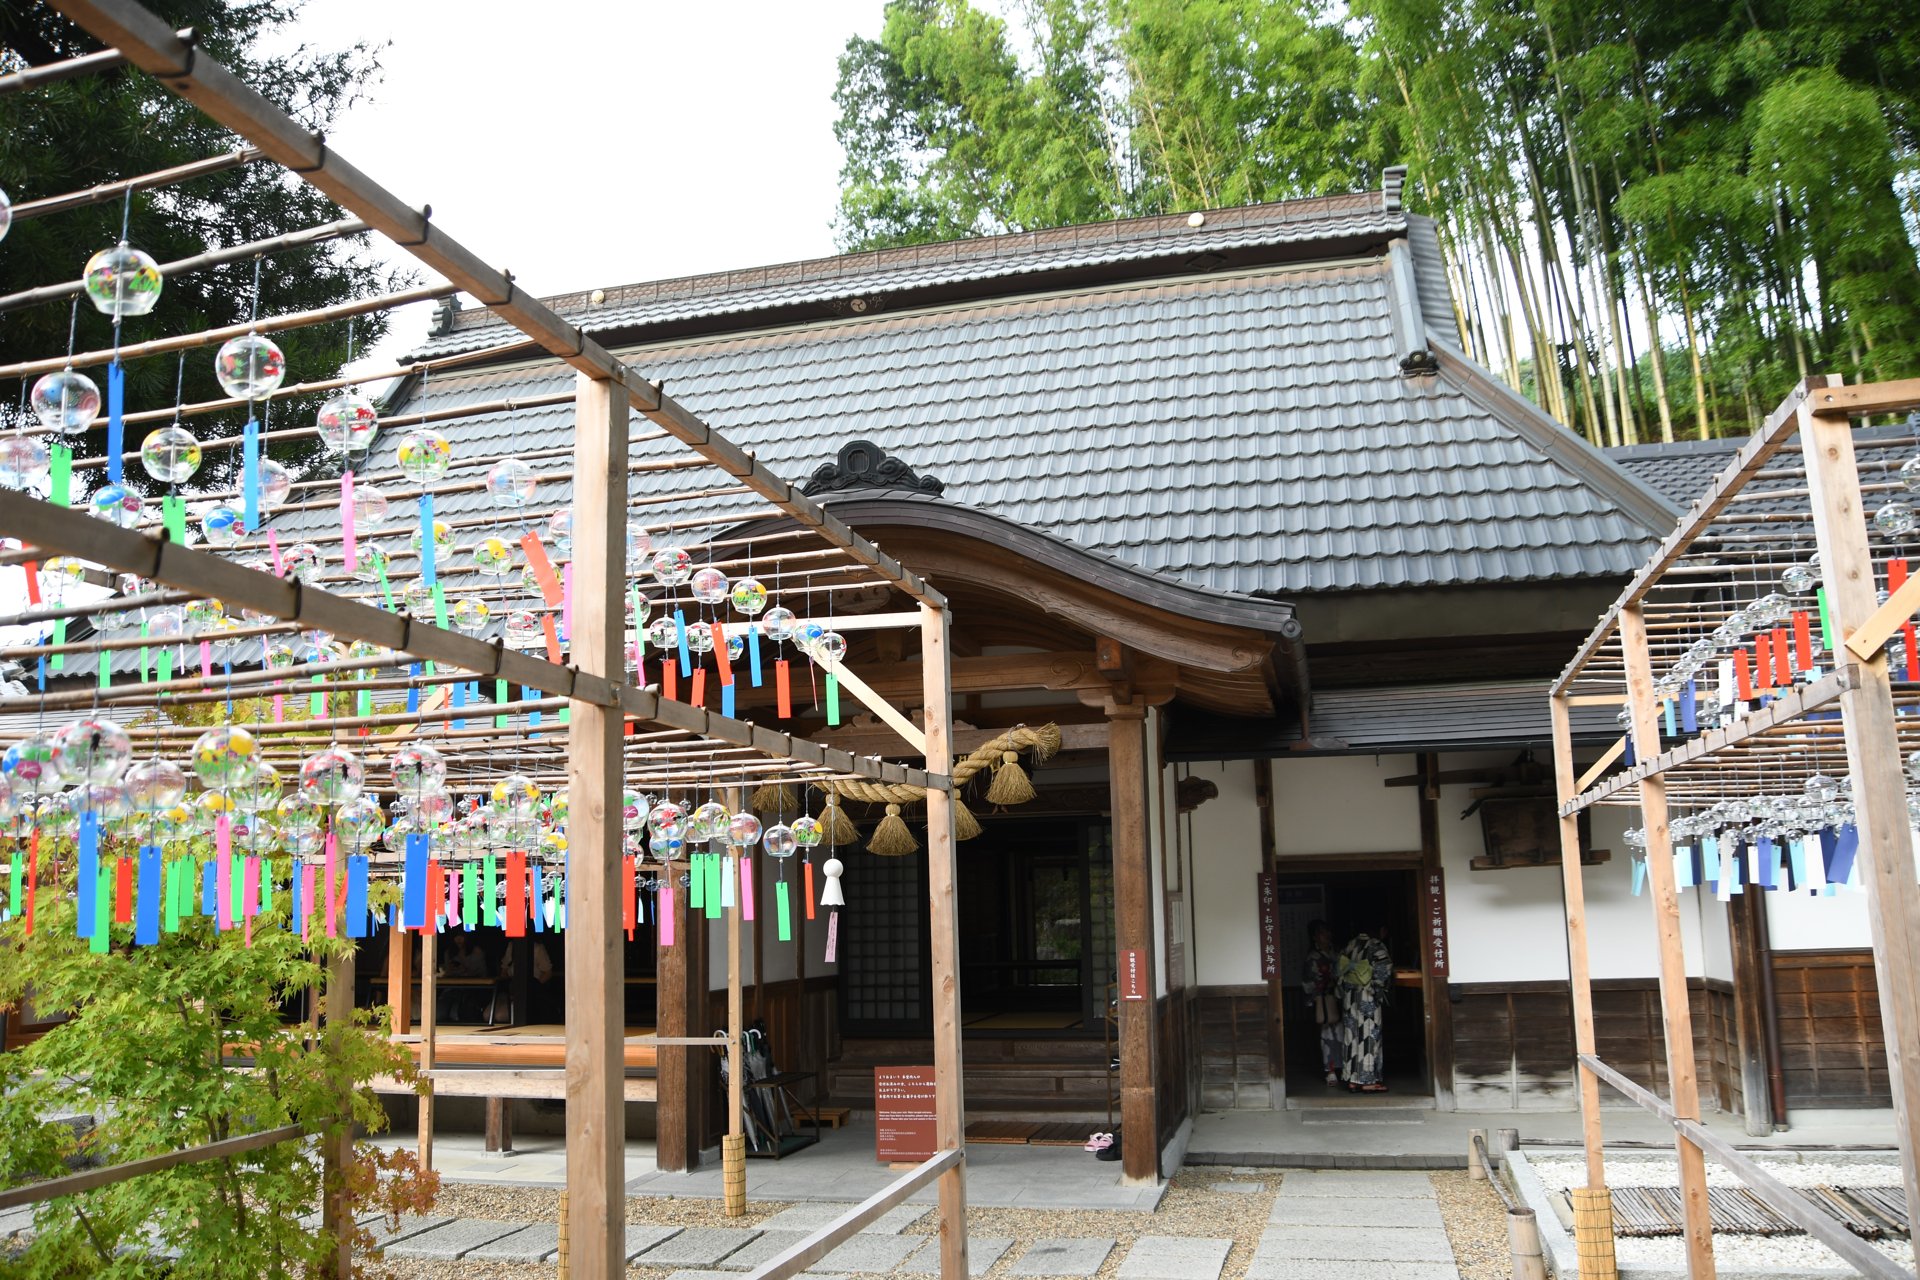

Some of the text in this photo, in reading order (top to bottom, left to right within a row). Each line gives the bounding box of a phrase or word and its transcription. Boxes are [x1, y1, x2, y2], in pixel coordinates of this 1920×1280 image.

[1263, 878, 1276, 975] ご朱印・お守り授与所
[1429, 875, 1445, 969] 拝観・ご祈願受付所
